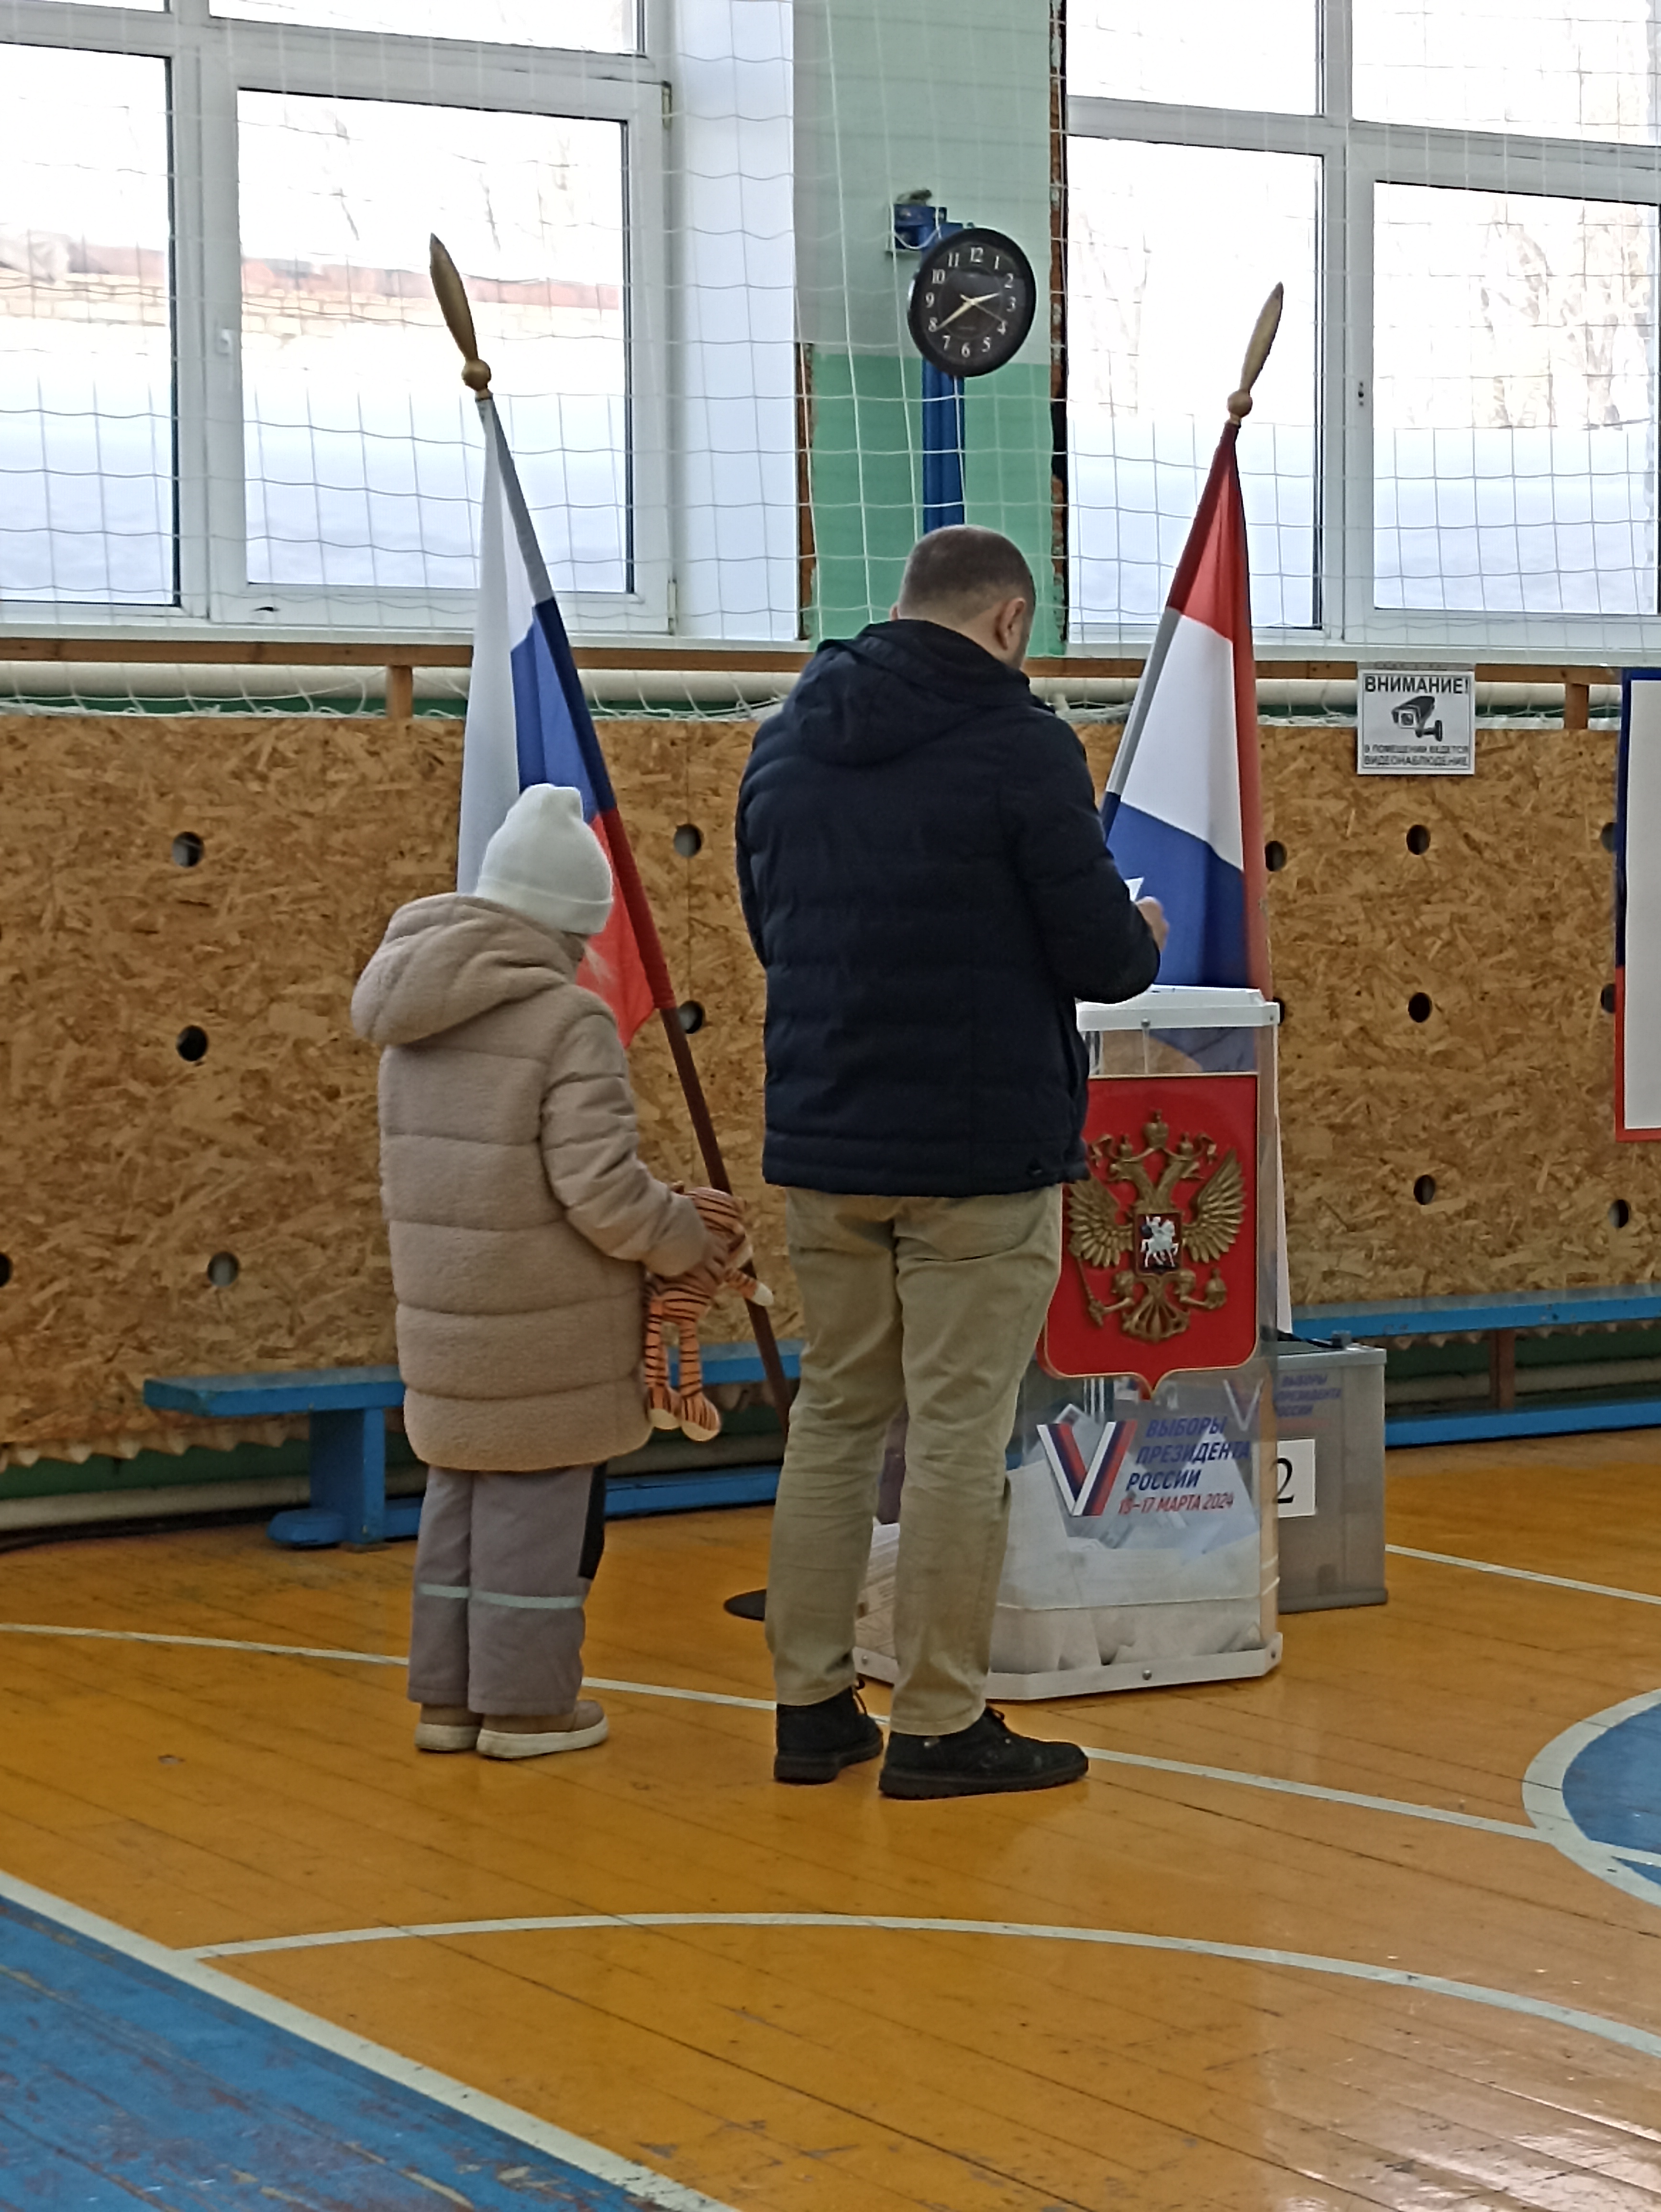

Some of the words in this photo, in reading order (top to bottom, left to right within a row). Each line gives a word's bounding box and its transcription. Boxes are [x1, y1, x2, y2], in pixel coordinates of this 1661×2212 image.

[948, 253, 959, 267] 11
[970, 247, 983, 263] 12
[994, 255, 1000, 270] 1
[932, 269, 945, 284] 10
[1005, 273, 1014, 288] 2
[925, 292, 935, 308] 9
[1006, 296, 1016, 312] 3
[928, 317, 938, 332] 8
[997, 320, 1008, 335] 4
[942, 335, 951, 350] 7
[961, 342, 970, 358] 6
[982, 337, 991, 353] 5
[1364, 676, 1468, 694] ВНИМАНИЕ!
[1146, 1416, 1228, 1438] ВЫБОРЫ
[1136, 1441, 1250, 1466] ПРЕЗИДЕНТА
[1126, 1469, 1201, 1492] РОССИИ
[1270, 1457, 1295, 1504] 2
[1156, 1493, 1201, 1513] МАРТА
[1202, 1491, 1235, 1510] 2024
